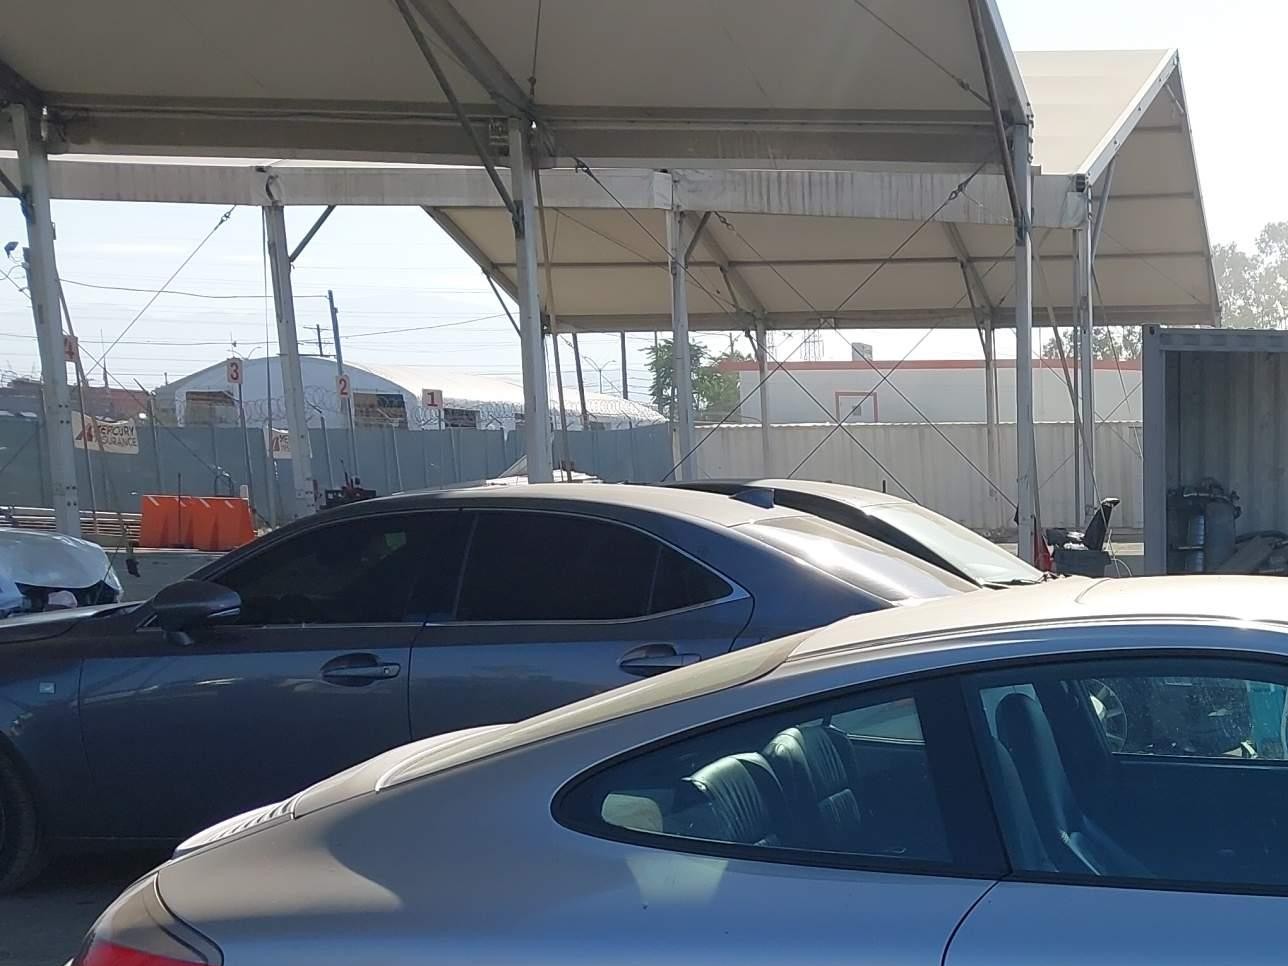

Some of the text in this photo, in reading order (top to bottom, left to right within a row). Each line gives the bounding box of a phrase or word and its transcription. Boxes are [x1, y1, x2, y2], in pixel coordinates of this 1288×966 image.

[230, 362, 239, 381] 3
[339, 378, 348, 395] 2
[426, 392, 438, 407] 1
